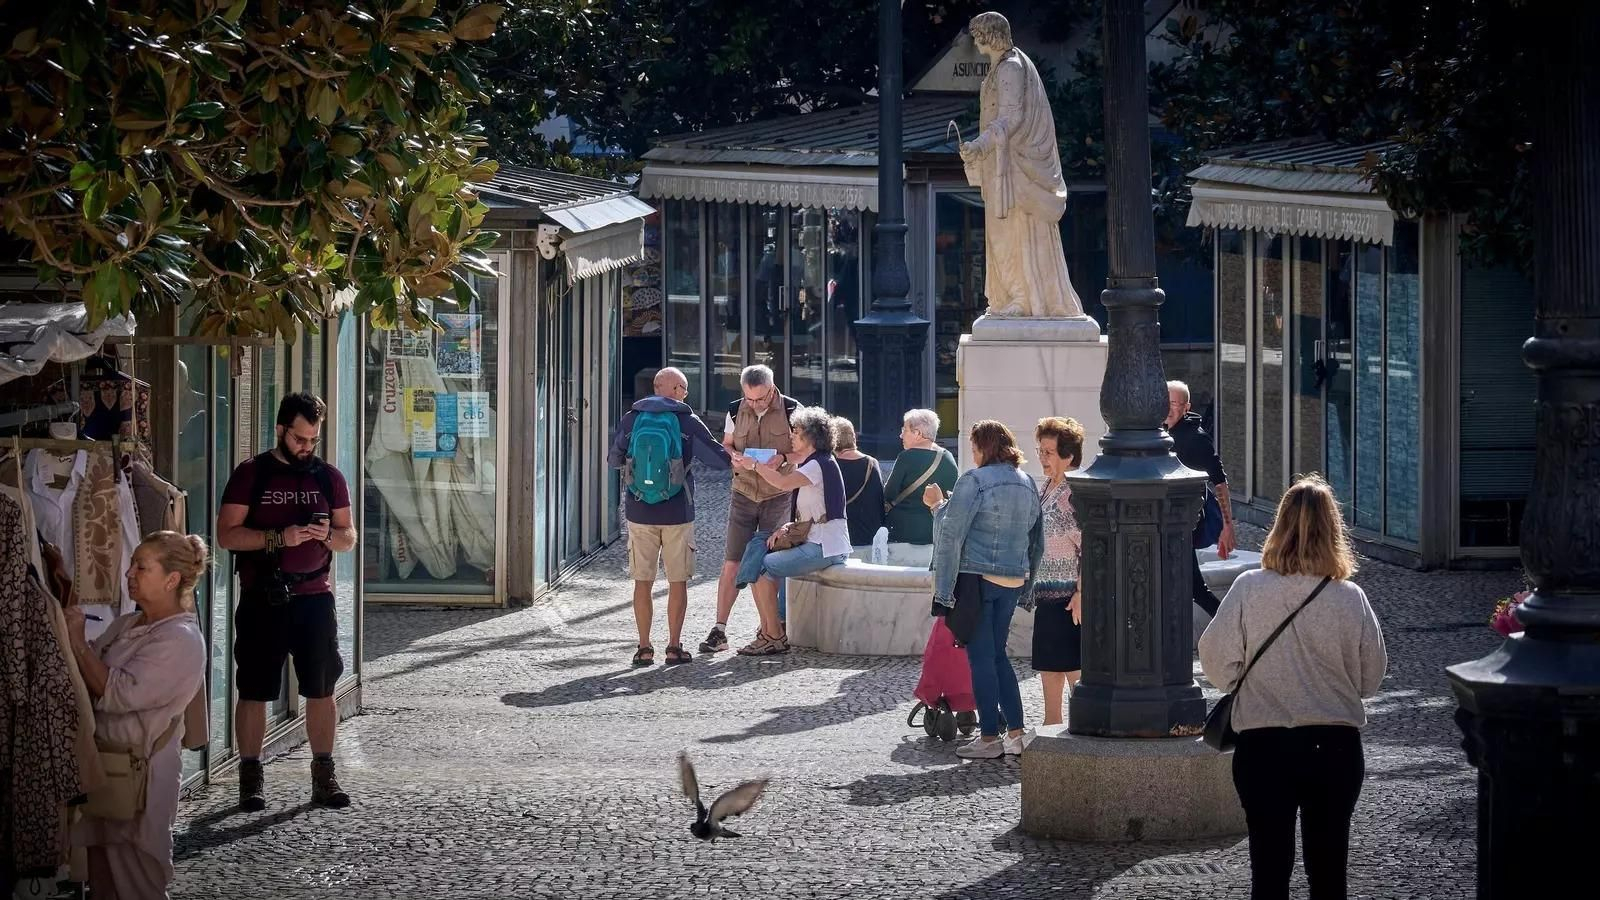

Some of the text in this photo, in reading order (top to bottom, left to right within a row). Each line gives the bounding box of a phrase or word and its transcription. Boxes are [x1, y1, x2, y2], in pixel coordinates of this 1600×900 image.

[751, 183, 766, 199] LAS
[770, 184, 799, 200] FLORES
[260, 490, 320, 505] ESPRIT
